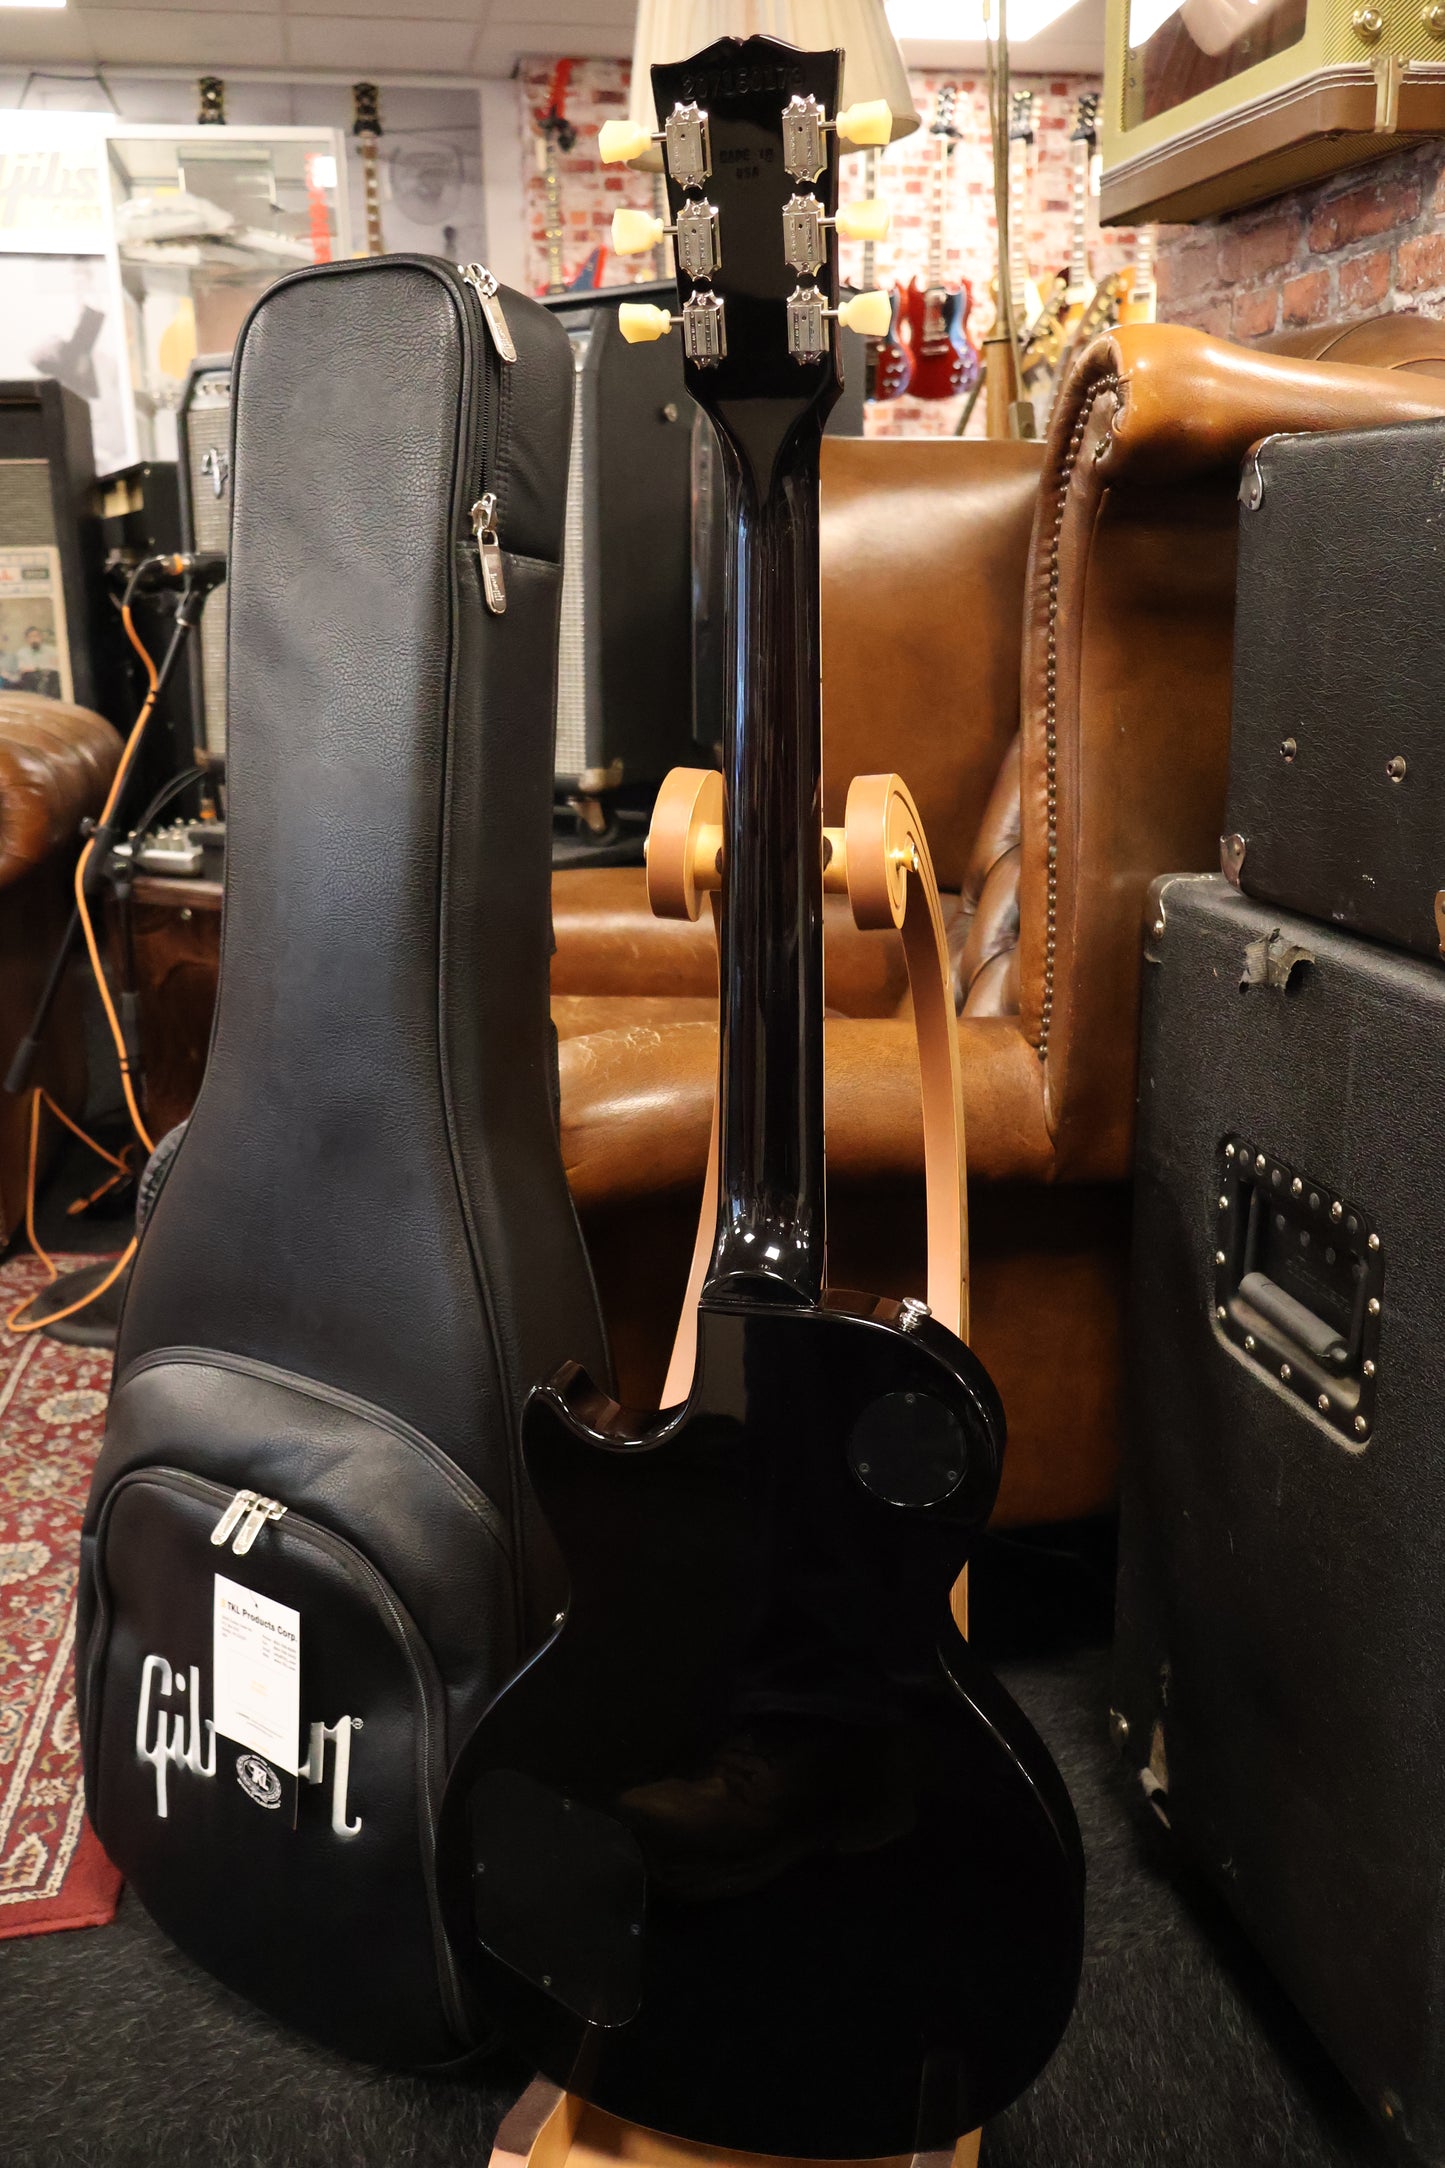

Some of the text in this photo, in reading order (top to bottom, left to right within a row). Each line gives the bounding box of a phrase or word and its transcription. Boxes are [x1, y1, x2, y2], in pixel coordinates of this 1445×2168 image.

[736, 166, 760, 179] USA
[227, 1601, 241, 1615] TKL
[242, 1608, 276, 1632] Products
